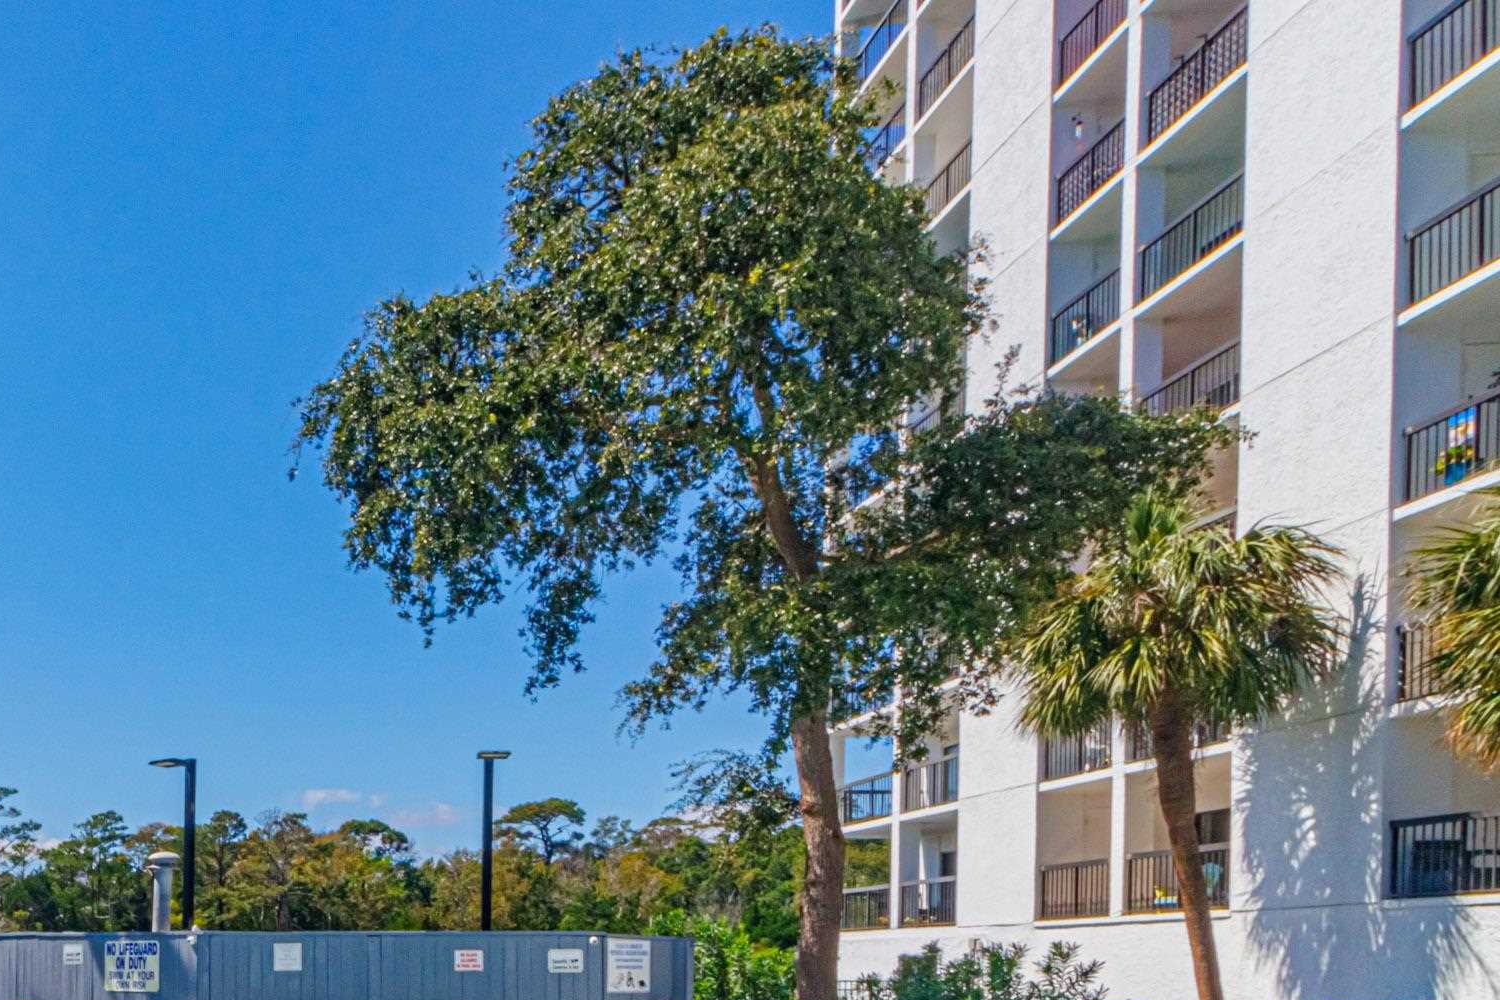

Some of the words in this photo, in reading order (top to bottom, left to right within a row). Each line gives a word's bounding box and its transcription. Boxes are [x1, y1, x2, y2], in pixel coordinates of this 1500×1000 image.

[107, 943, 116, 956] NO
[119, 943, 158, 956] LIFEGUARD
[116, 956, 125, 970] ON
[129, 956, 147, 970] DUTY
